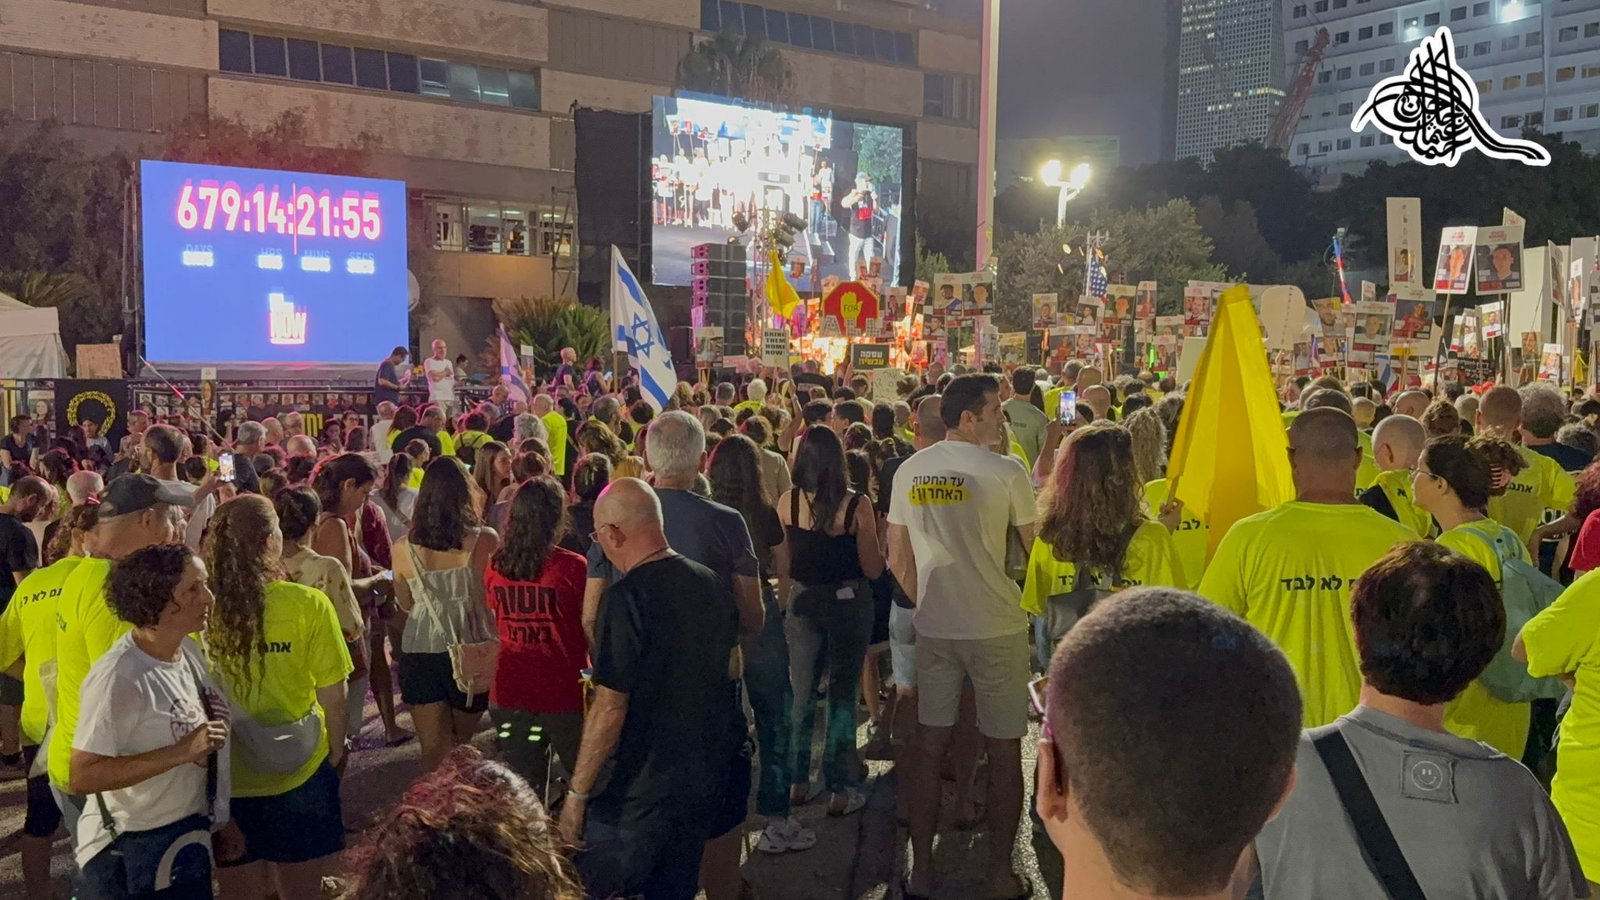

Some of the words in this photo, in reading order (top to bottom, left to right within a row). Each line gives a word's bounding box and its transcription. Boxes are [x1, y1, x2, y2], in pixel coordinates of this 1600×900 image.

[177, 184, 381, 240] 679:14:21:55
[843, 304, 859, 313] FOR
[912, 475, 947, 488] החטוף
[950, 475, 965, 487] עד
[911, 485, 963, 501] האחרון!
[1281, 574, 1315, 591] לבד
[1320, 574, 1342, 590] לא
[32, 590, 47, 602] לא
[493, 585, 558, 616] חטוף
